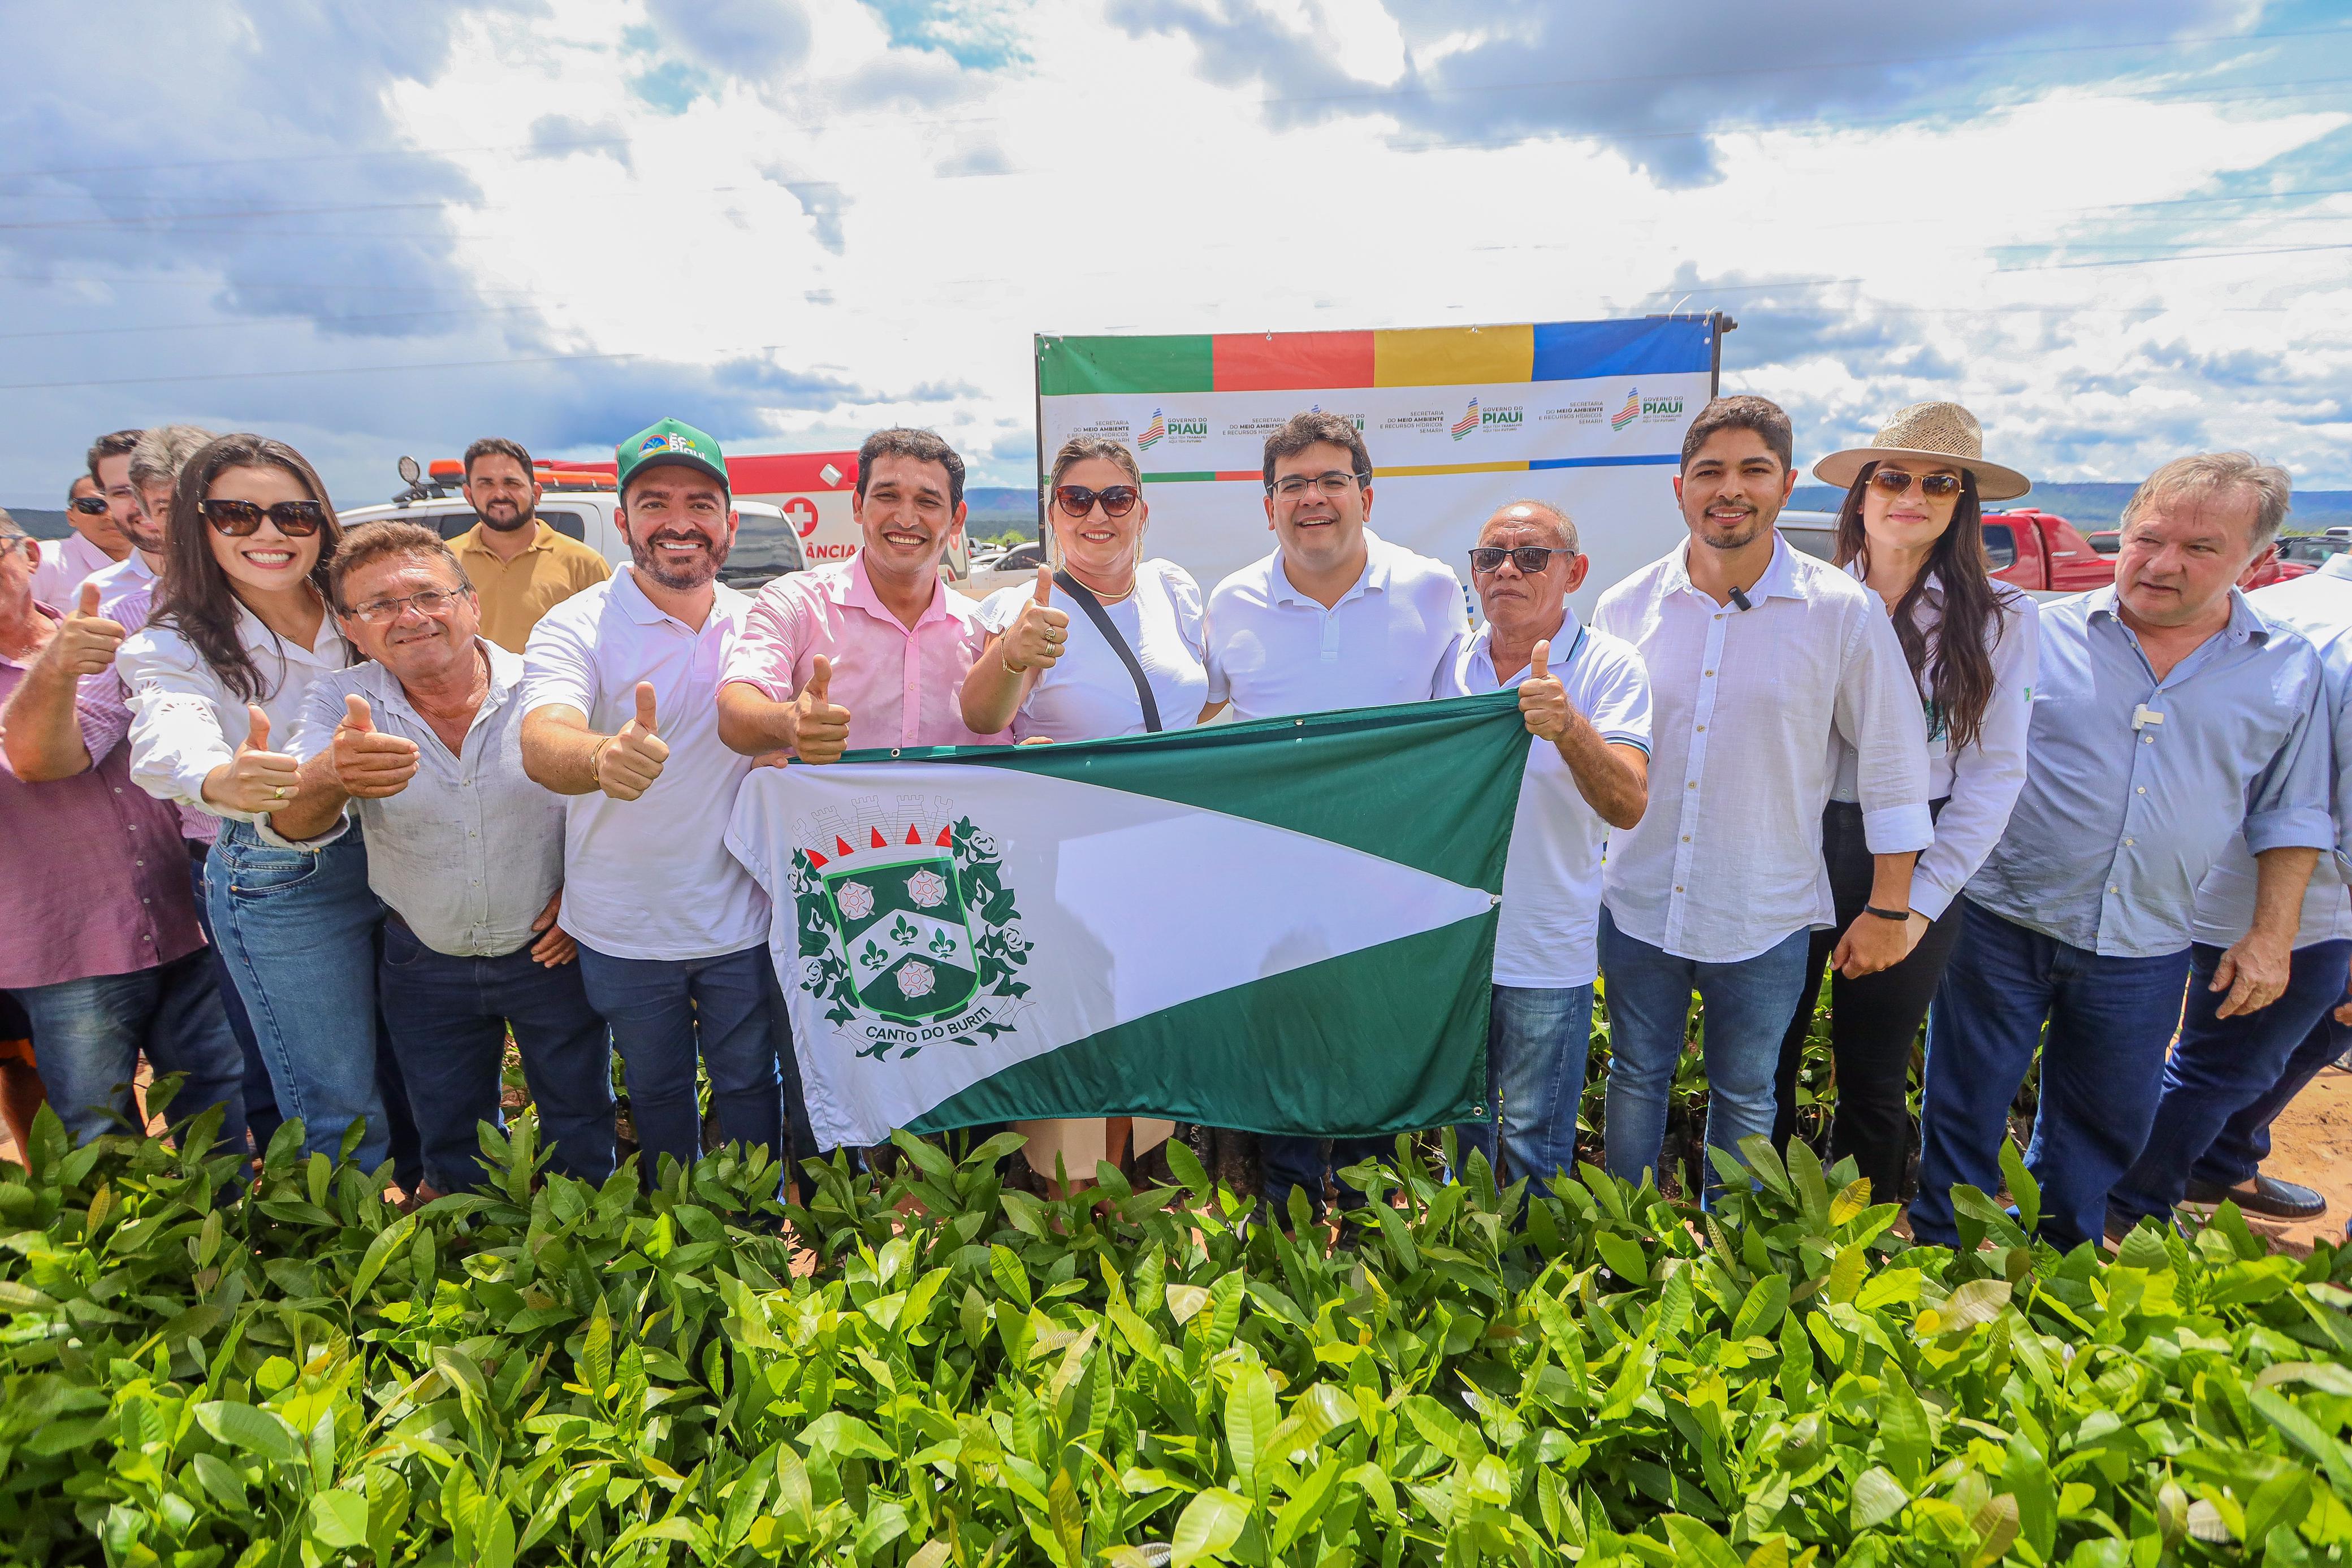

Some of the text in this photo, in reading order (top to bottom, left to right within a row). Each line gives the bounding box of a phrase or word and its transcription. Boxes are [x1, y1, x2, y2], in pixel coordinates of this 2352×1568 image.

[1643, 401, 1683, 414] PIAUÍ
[1482, 412, 1523, 424] PIAUÍ
[1168, 423, 1207, 435] PIAUÍ
[806, 542, 856, 558] ÂNCIA
[866, 1006, 992, 1043] CANTO DO BURITI
